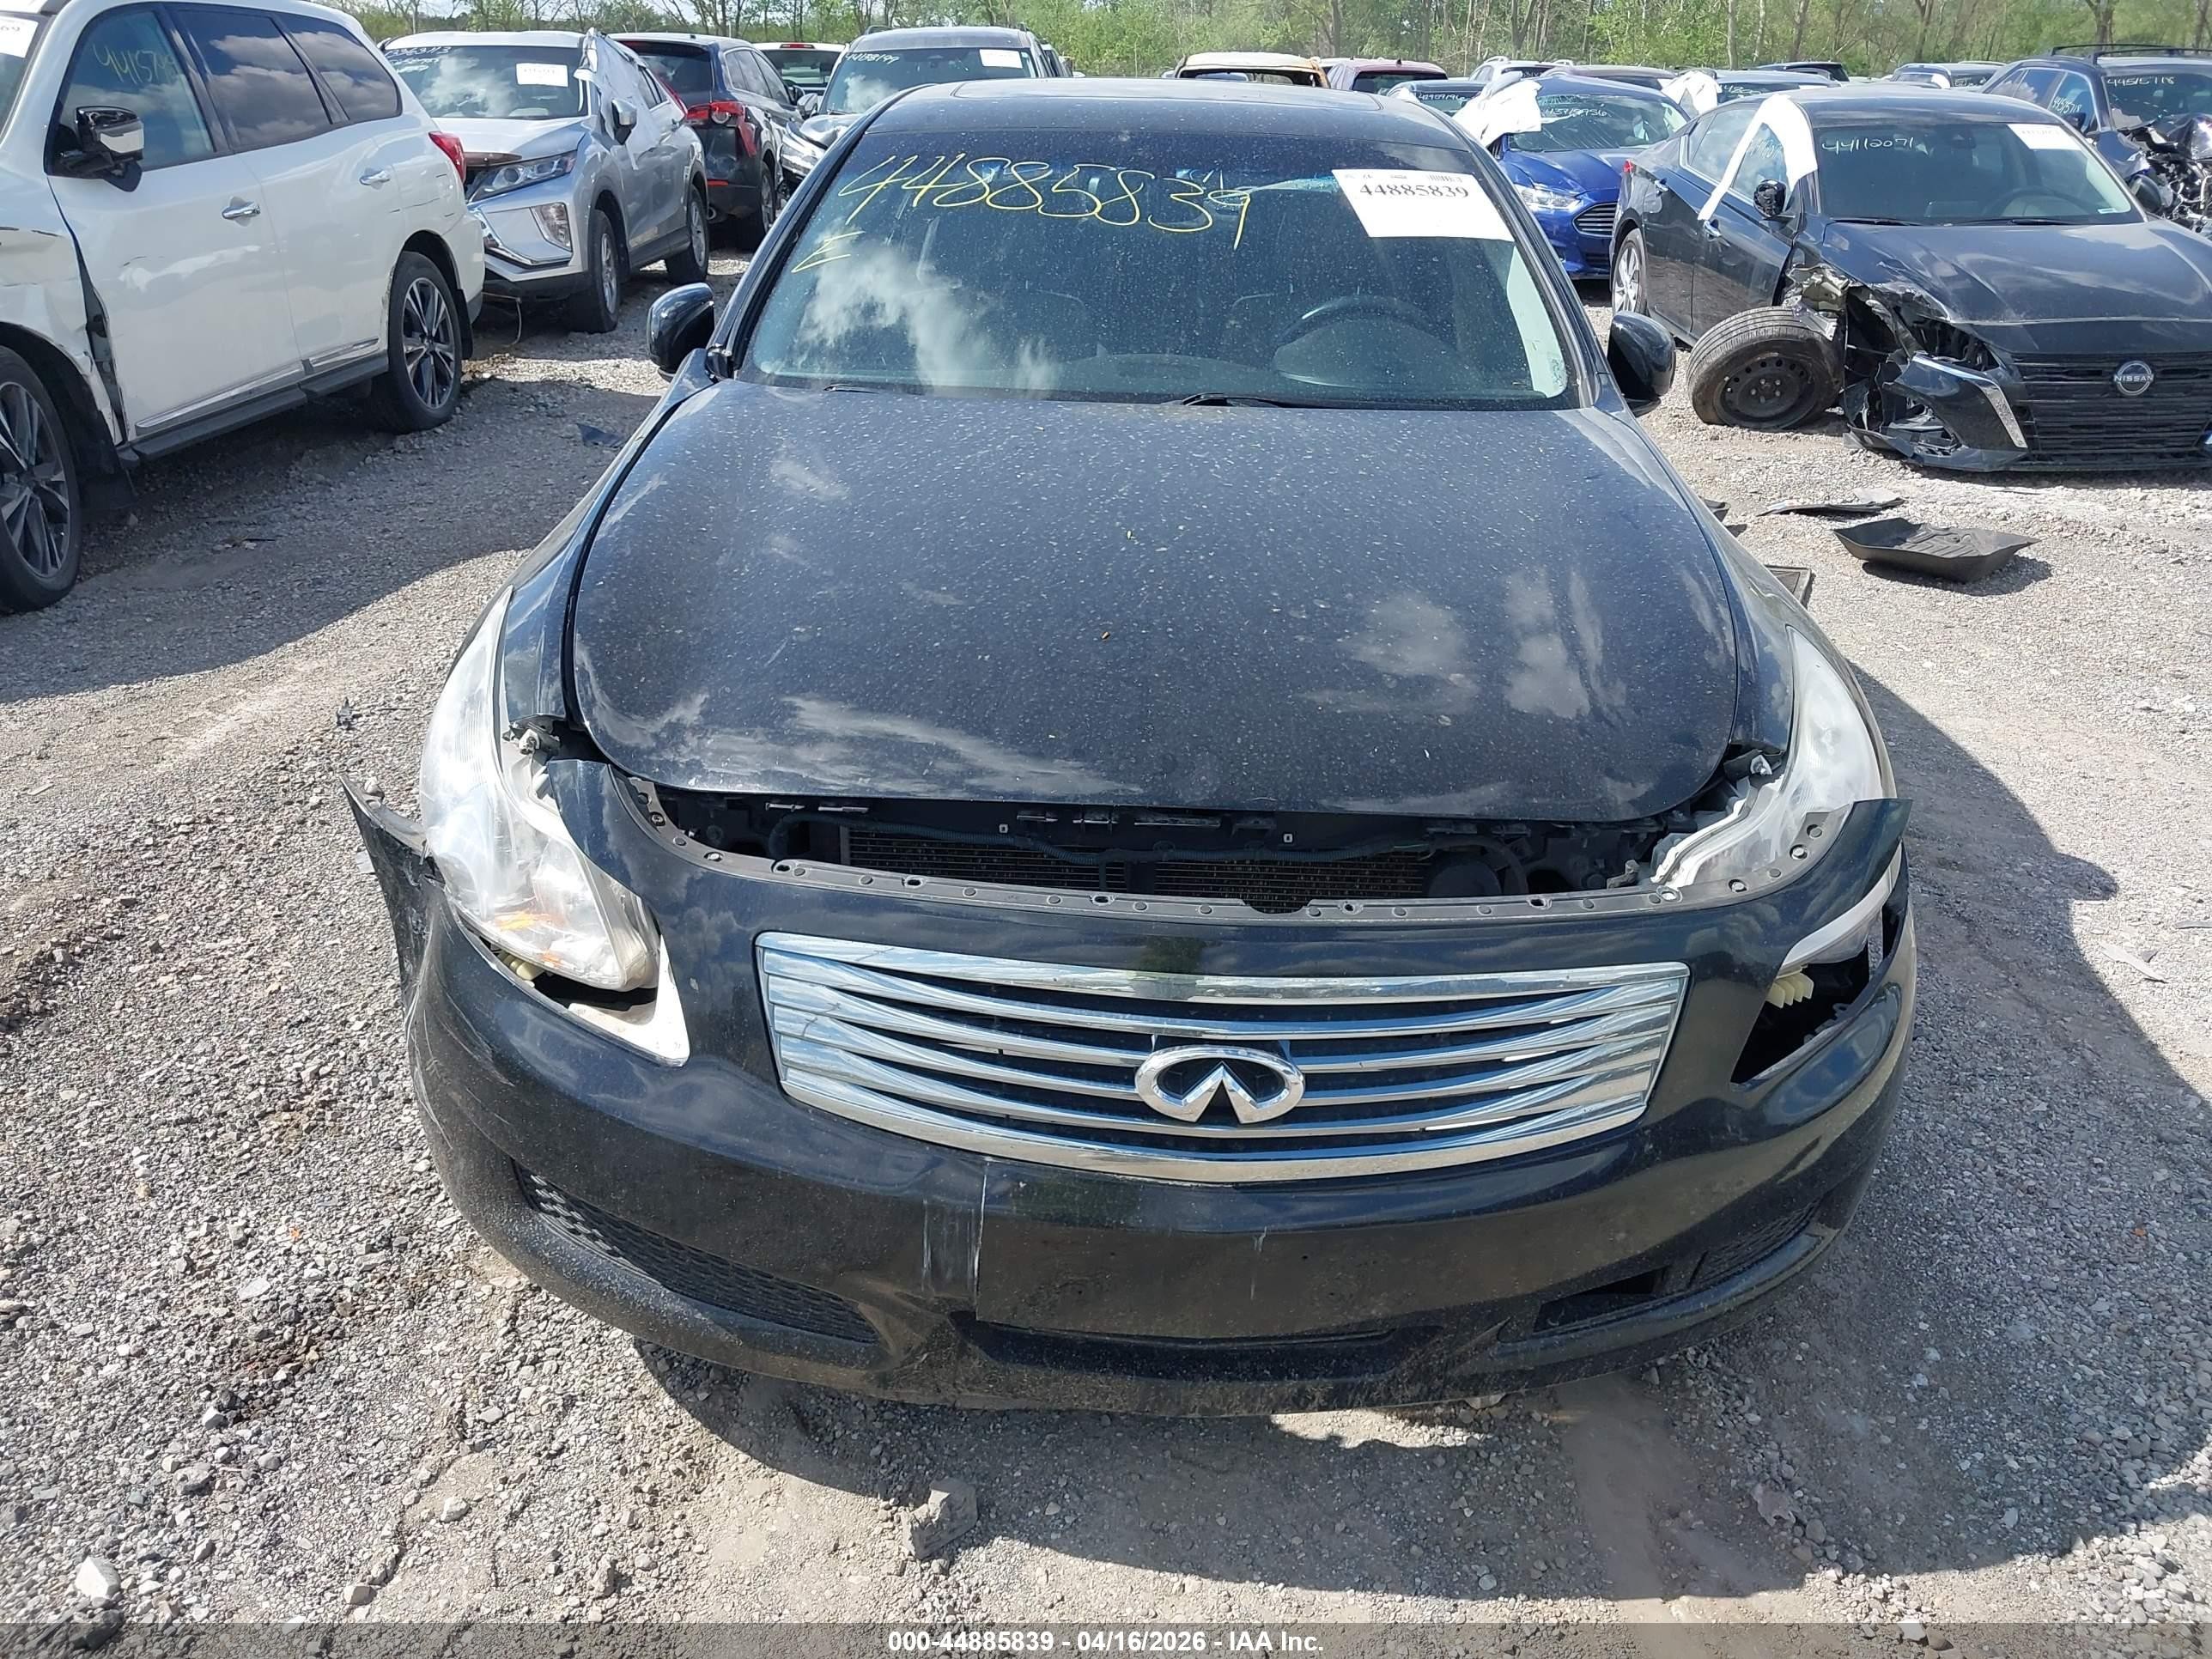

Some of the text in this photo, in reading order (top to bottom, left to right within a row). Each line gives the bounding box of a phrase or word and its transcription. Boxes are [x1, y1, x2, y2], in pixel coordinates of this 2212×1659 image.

[1821, 137, 1914, 155] 44112071
[1359, 184, 1469, 198] 44885839
[838, 153, 1251, 251] 44885839
[2113, 374, 2154, 382] NISSAN
